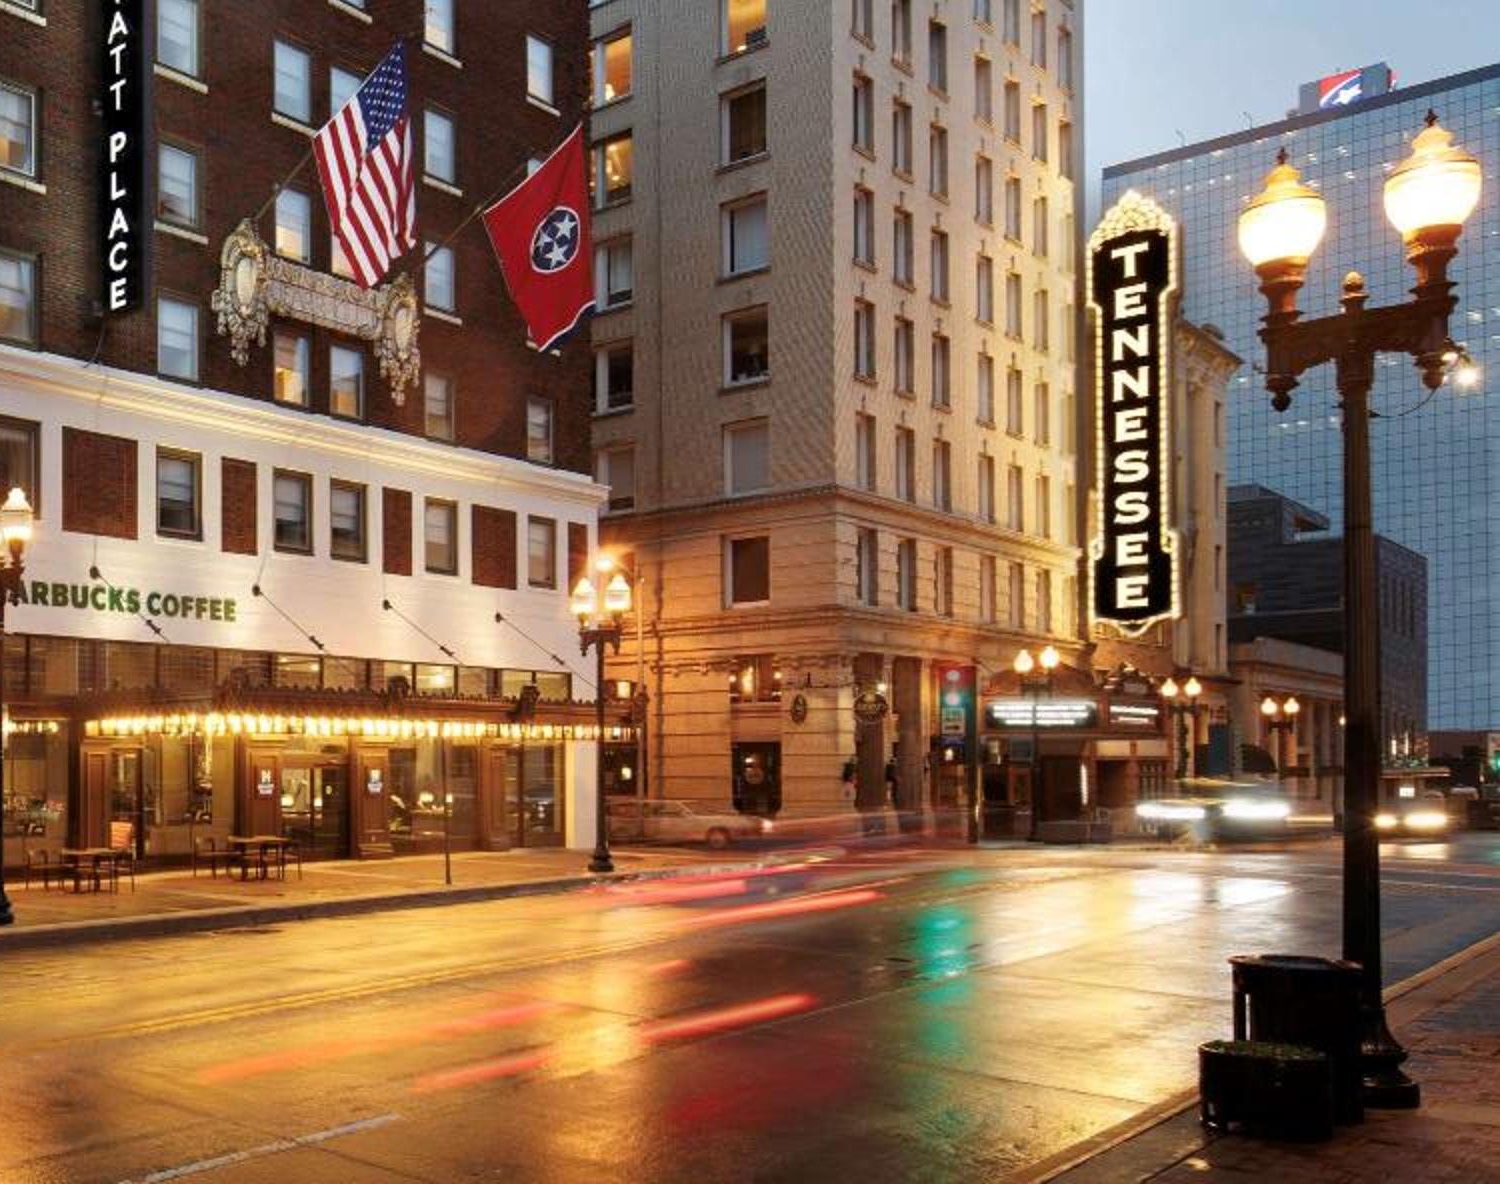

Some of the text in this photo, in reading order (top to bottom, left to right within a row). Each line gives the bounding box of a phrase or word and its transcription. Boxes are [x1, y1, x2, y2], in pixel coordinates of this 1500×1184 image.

[108, 131, 129, 310] PLACE
[1111, 241, 1151, 609] TENNESSEE
[147, 592, 237, 622] COFFEE
